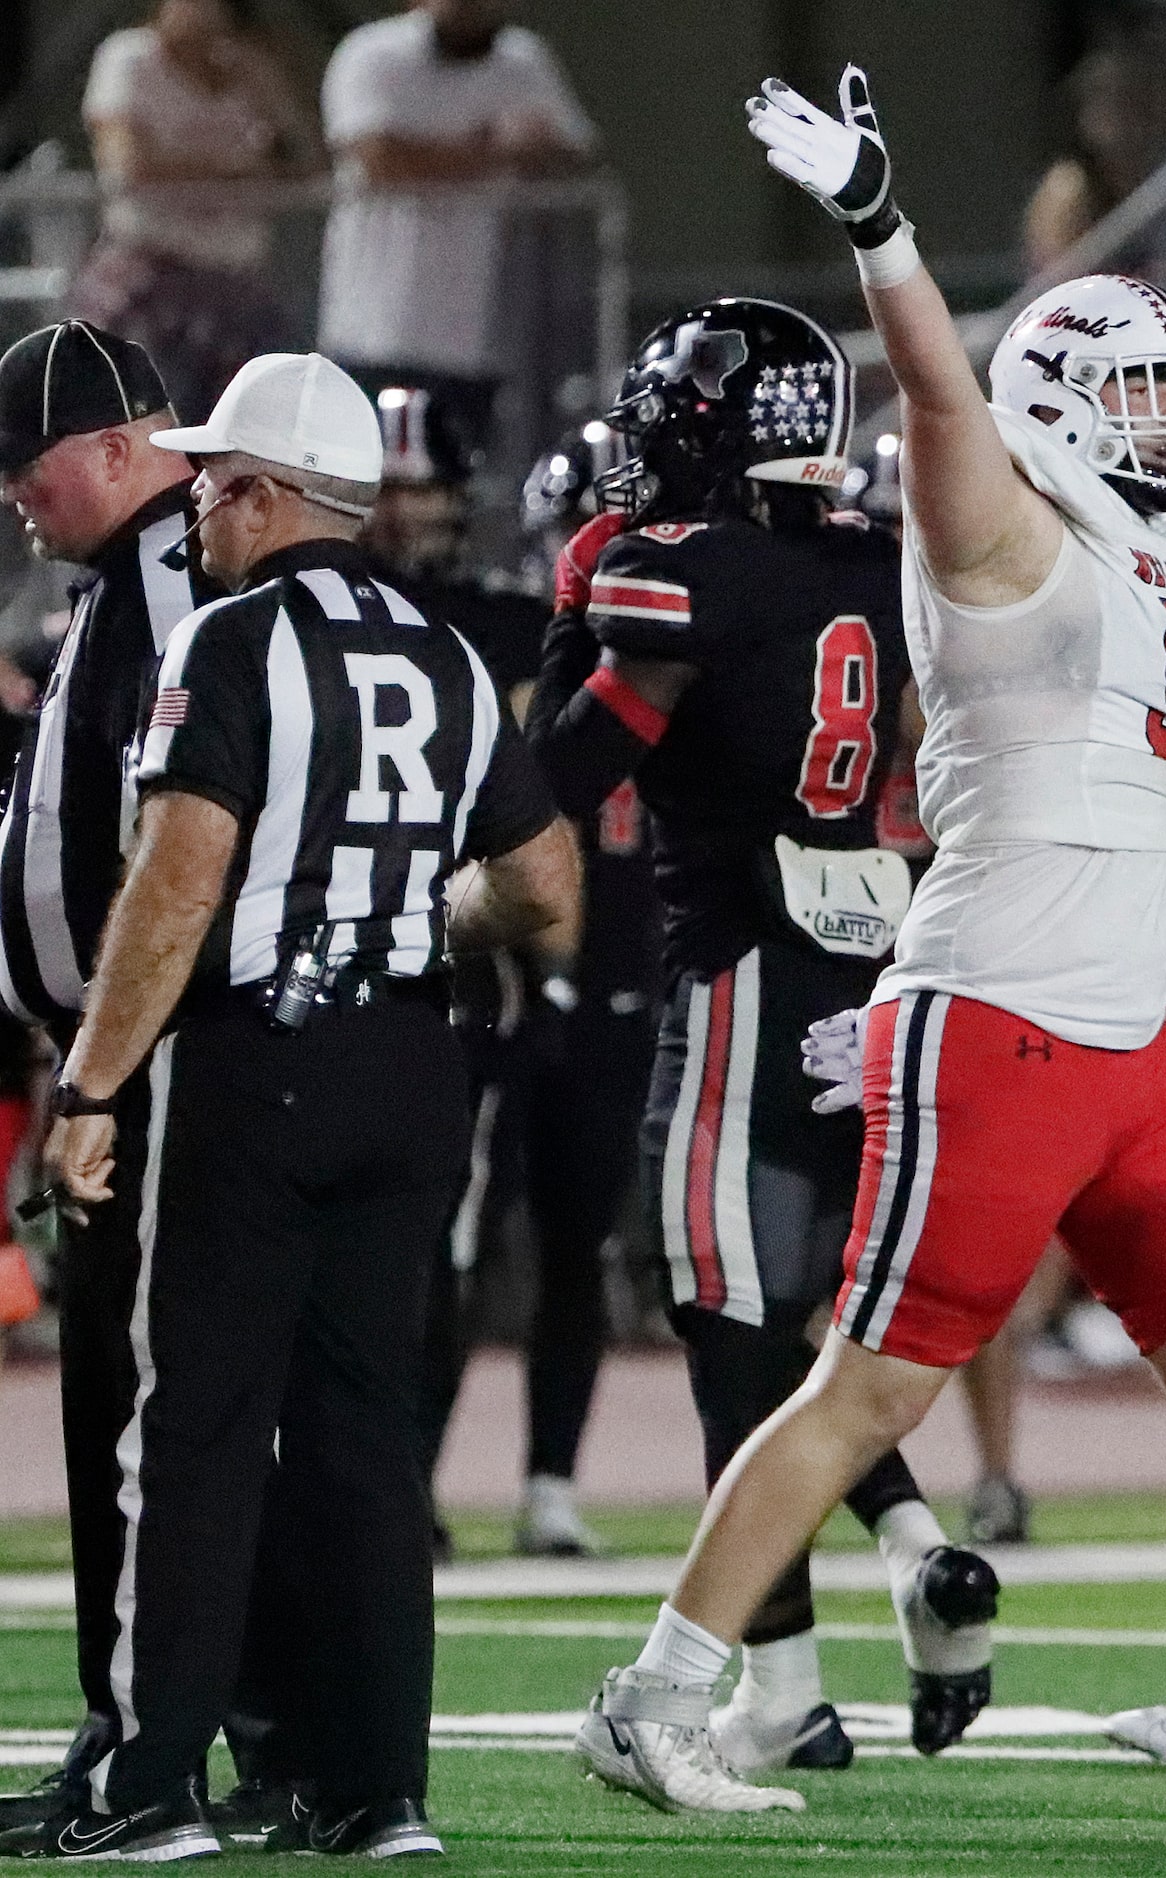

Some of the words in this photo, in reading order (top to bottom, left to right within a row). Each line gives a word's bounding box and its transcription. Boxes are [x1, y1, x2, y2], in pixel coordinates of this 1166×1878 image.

[1009, 305, 1131, 340] dinals
[343, 653, 444, 823] R
[796, 615, 878, 819] 8
